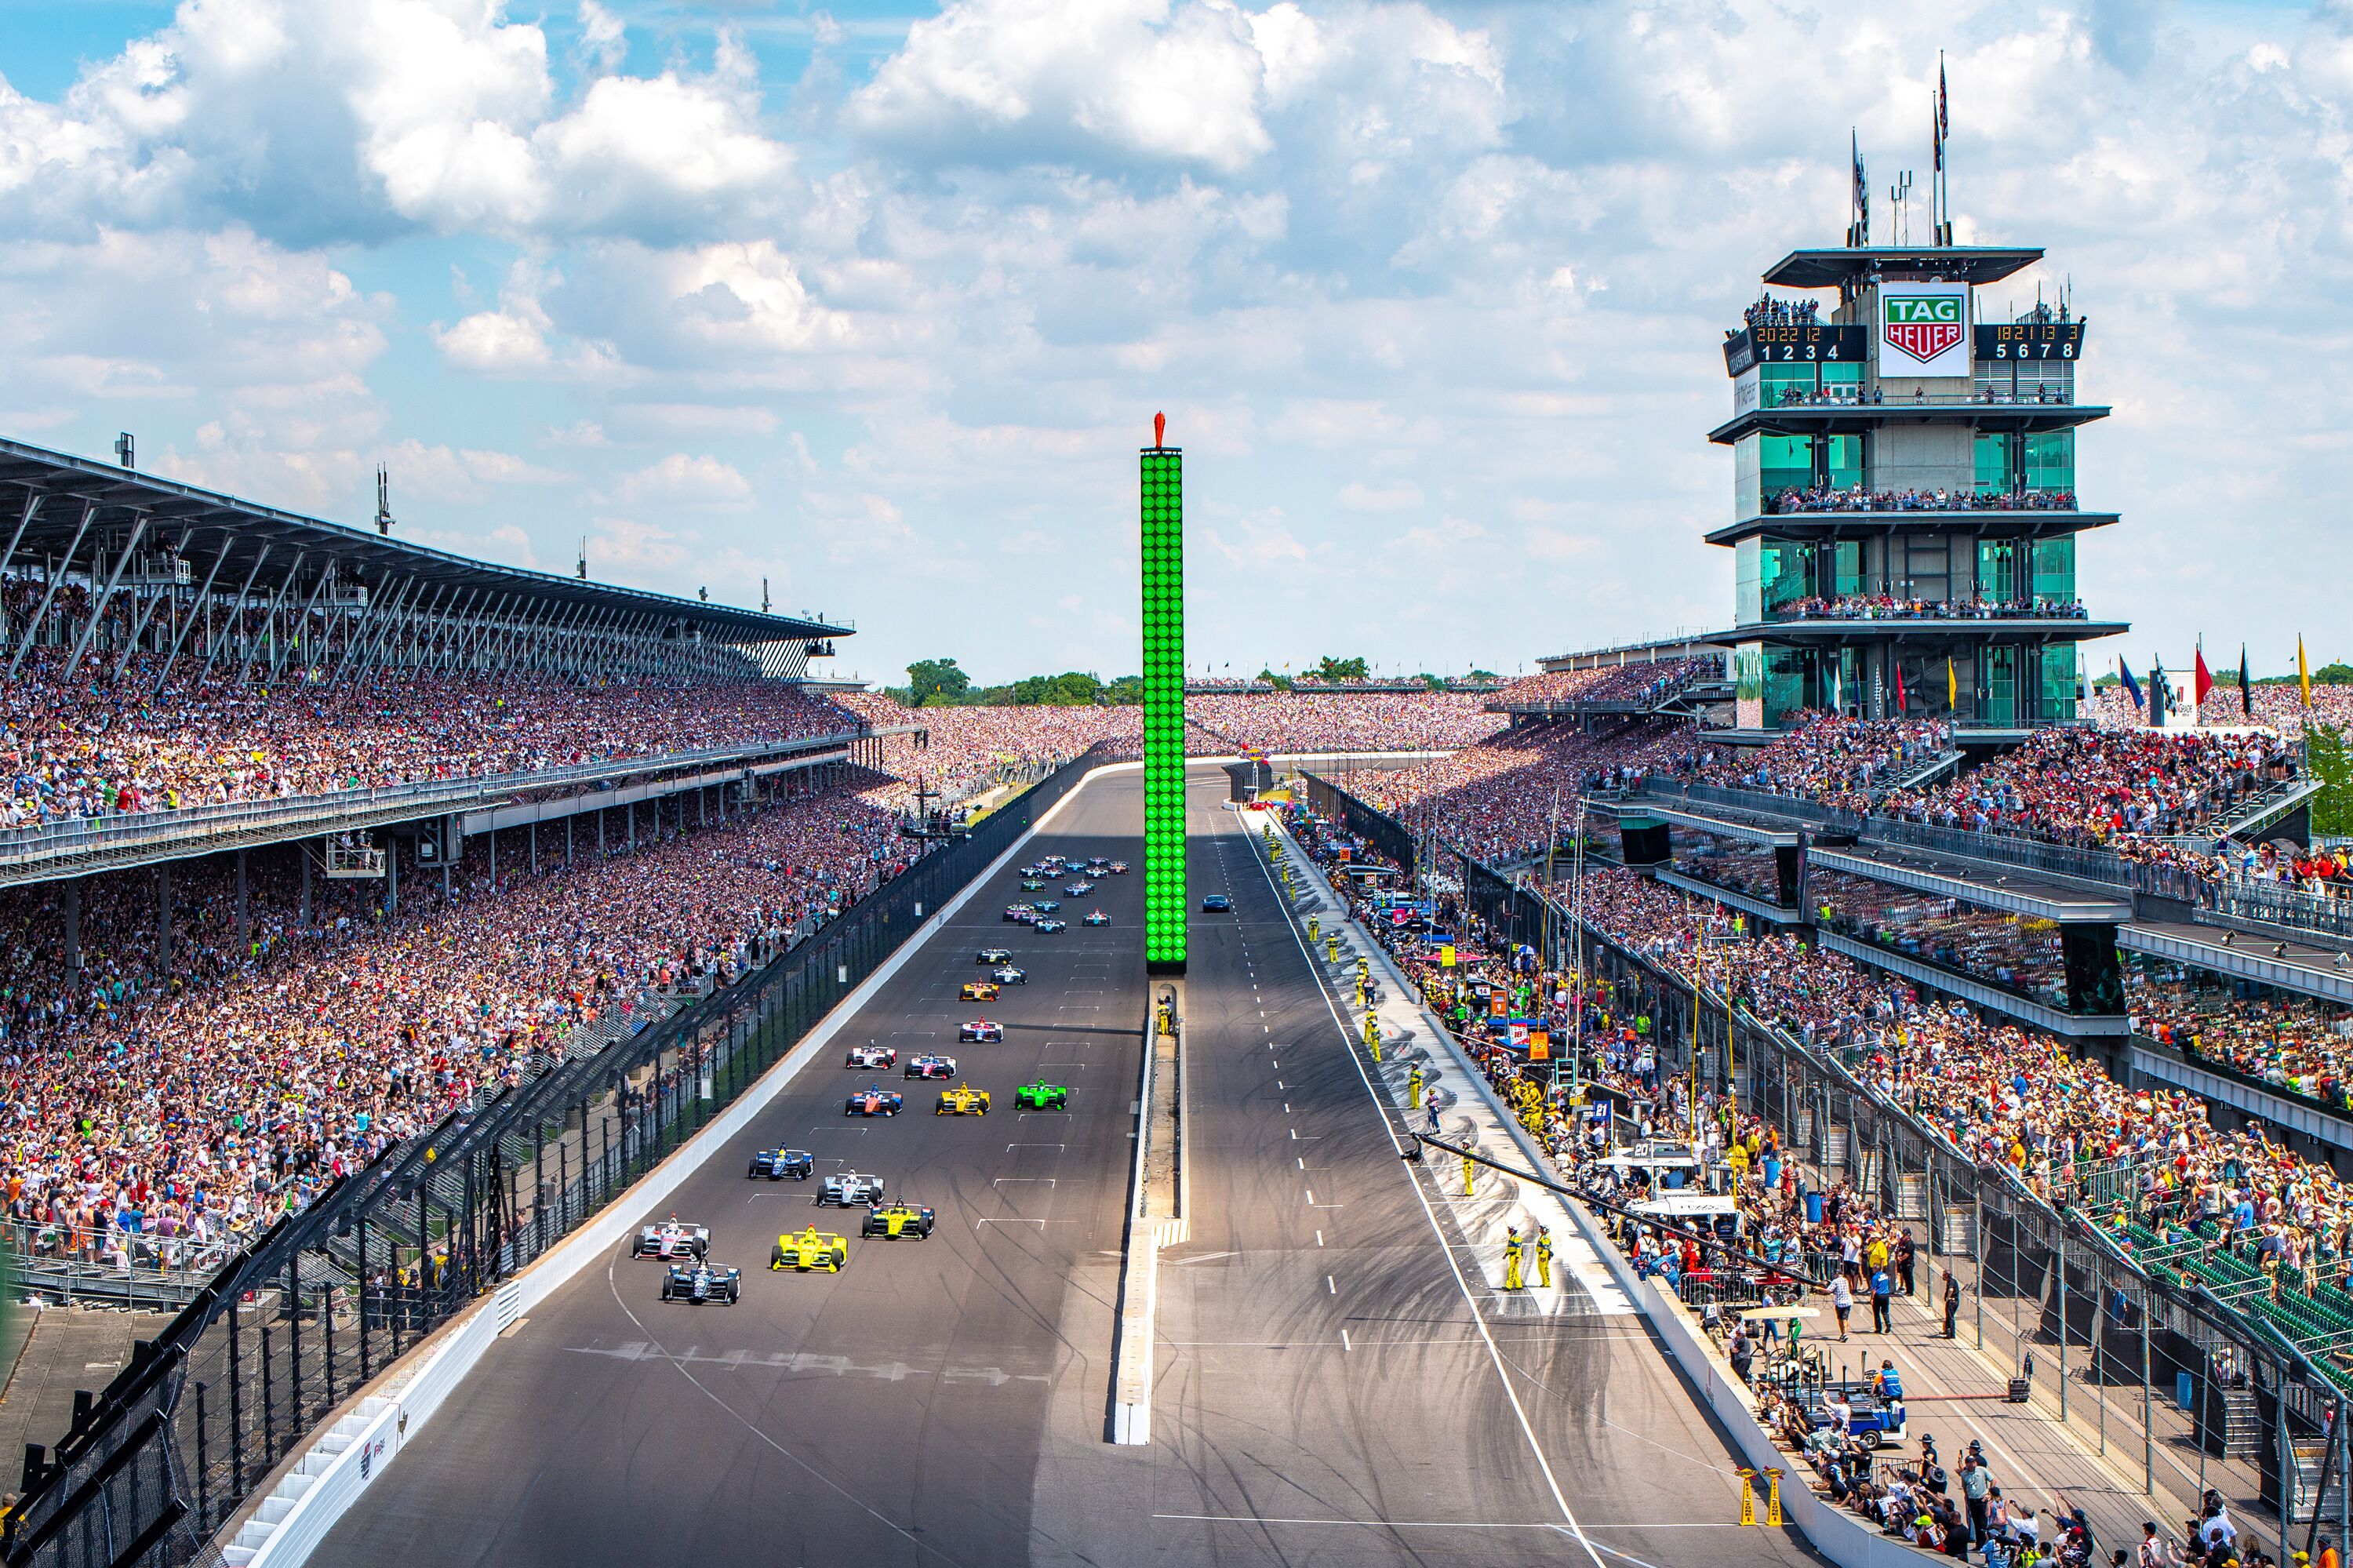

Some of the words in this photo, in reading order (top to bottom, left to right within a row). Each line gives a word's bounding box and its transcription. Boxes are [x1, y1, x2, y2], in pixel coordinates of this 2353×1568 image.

[1891, 300, 1955, 321] TAG
[1757, 327, 1776, 342] 20
[1779, 327, 1798, 342] 22
[1807, 327, 1820, 342] 12
[1997, 326, 2011, 340] 18
[2014, 326, 2033, 340] 21
[2042, 326, 2055, 340] 13
[2068, 326, 2078, 340] 3
[1890, 326, 1958, 357] HEUER
[1762, 345, 1770, 361] 1
[1783, 345, 1794, 361] 2
[1806, 345, 1817, 360] 3
[1827, 344, 1838, 360] 4
[1996, 344, 2006, 358] 5
[2018, 344, 2029, 358] 6
[2041, 344, 2052, 358] 7
[2063, 344, 2073, 358] 8
[1595, 1104, 1608, 1117] 21
[1634, 1143, 1649, 1157] 20
